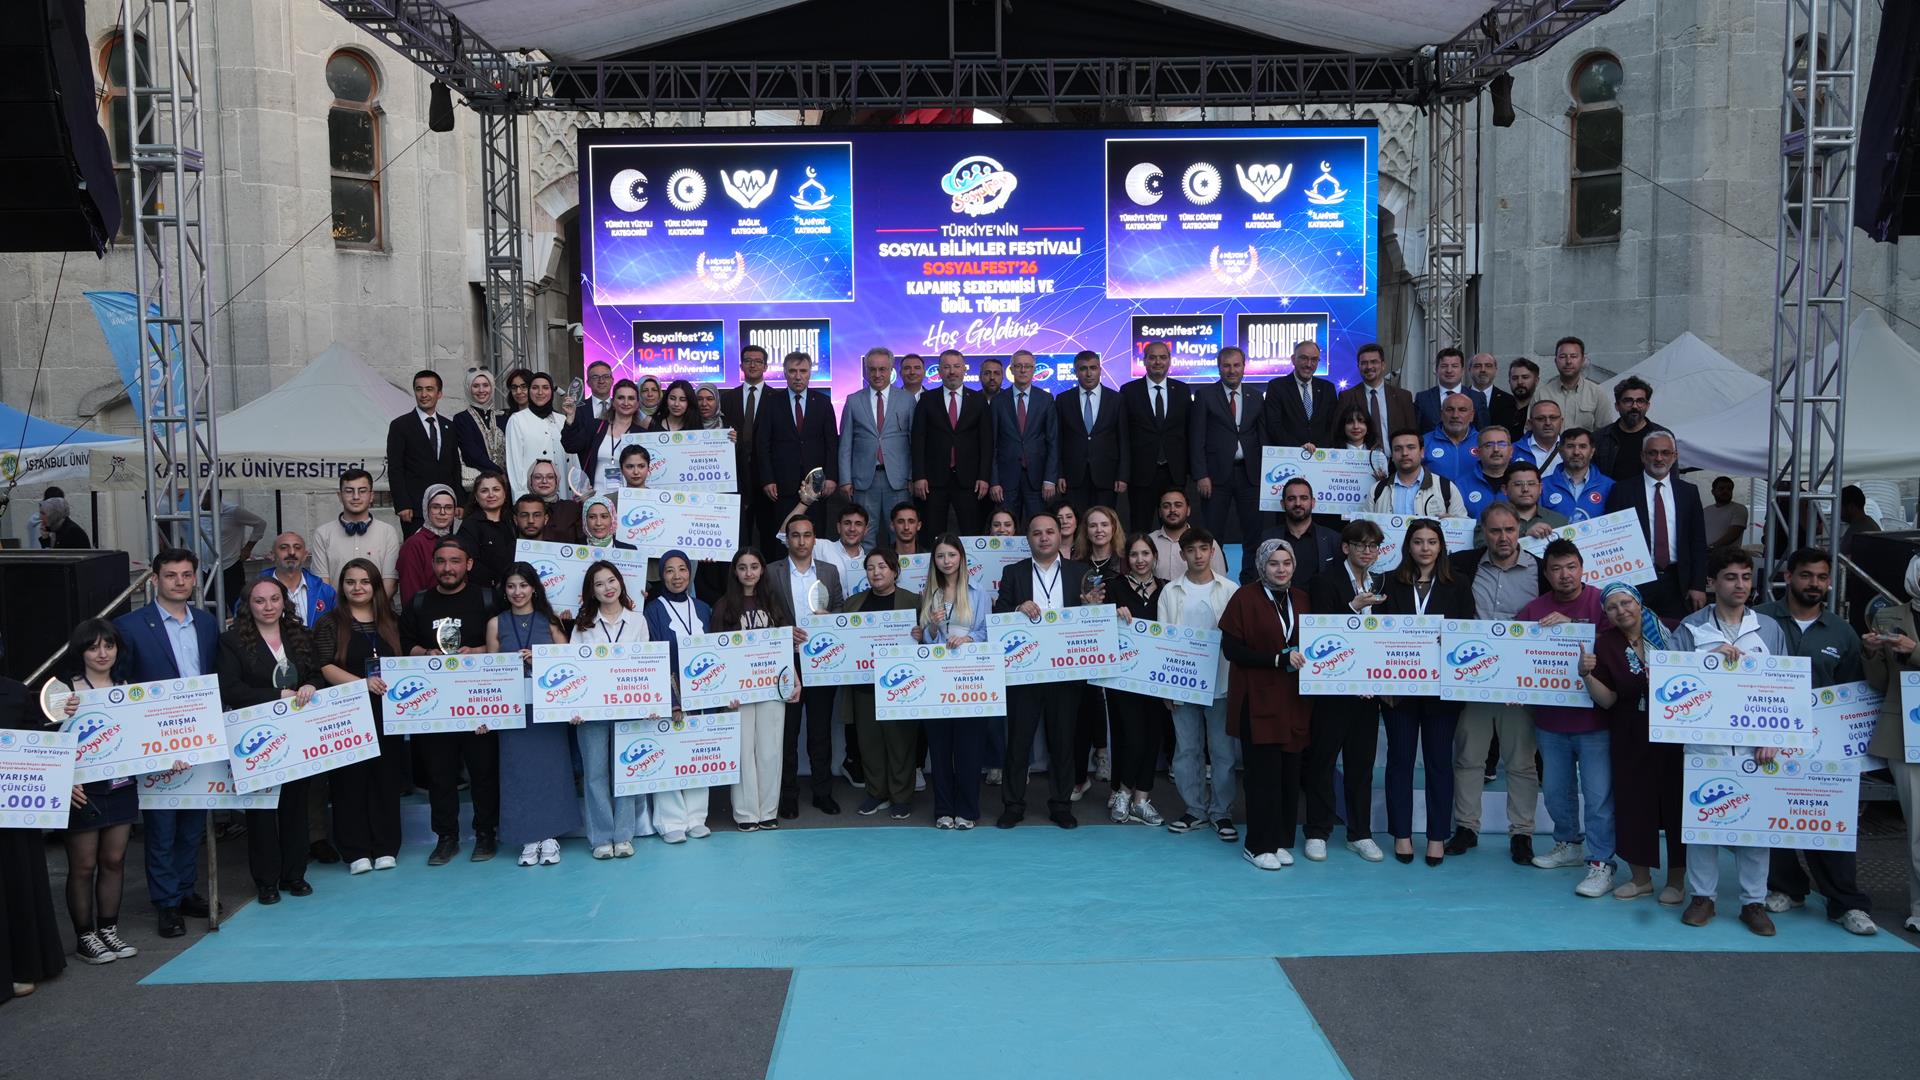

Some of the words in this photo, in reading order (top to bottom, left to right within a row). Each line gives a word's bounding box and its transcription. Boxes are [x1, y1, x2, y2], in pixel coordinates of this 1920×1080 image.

[941, 222, 1018, 237] TÜRKİYE'NİN
[879, 243, 937, 257] SOSYAL
[940, 239, 1006, 256] BİLİMLER
[1009, 238, 1081, 255] FESTİVALİ
[923, 261, 1038, 275] SOSYALFEST'26
[906, 281, 960, 297] KAPANIŞ
[963, 277, 1035, 294] SEREMONİSİ
[1037, 279, 1055, 293] VE
[941, 297, 973, 313] ÖDÜL
[975, 296, 1020, 313] TÖRENİ
[642, 331, 714, 344] Sosyalfest'26
[923, 320, 960, 348] Hoş
[965, 317, 1040, 348] Geldiniz
[1141, 325, 1213, 338] Sosyalfest'26
[1176, 341, 1218, 356] Mayıs
[638, 348, 675, 361] 10-11
[677, 348, 720, 363] Mayıs
[638, 364, 672, 374] İstanbul
[673, 363, 720, 374] Üniversitesi
[25, 457, 68, 471] İSTANBUL
[70, 452, 90, 466] ÜNİV
[688, 463, 720, 472] ÜÇÜNCÜSÜ
[690, 458, 718, 466] YARIŞMA
[155, 458, 237, 478] KRBÜK
[242, 458, 366, 478] ÜNİVERSİTESİ
[679, 471, 721, 482] 30.000
[1328, 484, 1361, 492] ÜÇÜNCÜSÜ
[1317, 491, 1361, 502] 30.000
[691, 521, 720, 530] YARIŞMA
[688, 527, 722, 537] ÜÇÜNCÜSÜ
[676, 535, 722, 548] 30.000
[1592, 546, 1624, 559] YARIŞMA
[1596, 554, 1624, 566] İKİNCİSİ
[1582, 561, 1632, 582] 70.000
[1066, 638, 1098, 647] YARIŞMA
[1067, 646, 1099, 654] BİRİNCİSİ
[1386, 650, 1421, 659] YARIŞMA
[1525, 649, 1578, 657] Fotomaraton
[750, 659, 777, 668] YARIŞMA
[1050, 653, 1106, 668] 100.000
[1165, 656, 1196, 667] YARIŞMA
[1385, 658, 1421, 666] BİRİNCİSİ
[1532, 659, 1569, 667] YARIŞMA
[1162, 663, 1198, 675] ÜÇÜNCÜSÜ
[1366, 668, 1428, 680] 100.000
[616, 676, 649, 684] YARIŞMA
[738, 676, 779, 689] 70.000
[953, 675, 985, 683] YARIŞMA
[1149, 671, 1197, 687] 30.000
[1516, 676, 1571, 689] 10.000
[616, 683, 650, 691] BİRİNCİSİ
[955, 683, 983, 691] İKİNCİSİ
[468, 695, 503, 703] BİRİNCİSİ
[603, 693, 651, 705] 15.000
[940, 692, 988, 704] 70.000
[1747, 695, 1786, 705] YARIŞMA
[450, 704, 510, 717] 100.000
[1744, 704, 1789, 714] ÜÇÜNCÜSÜ
[158, 717, 197, 728] YARIŞMA
[318, 720, 352, 733] YARIŞMA
[1729, 714, 1790, 730] 30.000
[1849, 720, 1876, 730] YARIŞM
[161, 726, 196, 737] İKİNCİSİ
[319, 728, 354, 742] BİRİNCİSİ
[1848, 731, 1873, 741] ÜÇÜNC
[141, 735, 203, 756] 70.000
[302, 734, 363, 760] 100.000
[691, 746, 721, 754] YARIŞMA
[1843, 741, 1871, 756] 5.0
[691, 753, 721, 762] BİRİNCİSİ
[674, 761, 727, 775] 100.000
[0, 773, 44, 783] YARIŞMA
[0, 783, 46, 793] ÇÜNCÜSÜ
[0, 795, 46, 809] .000
[1787, 798, 1829, 808] YARIŞMA
[1790, 807, 1826, 817] İKİNCİSİ
[1767, 817, 1832, 832] 70.000
